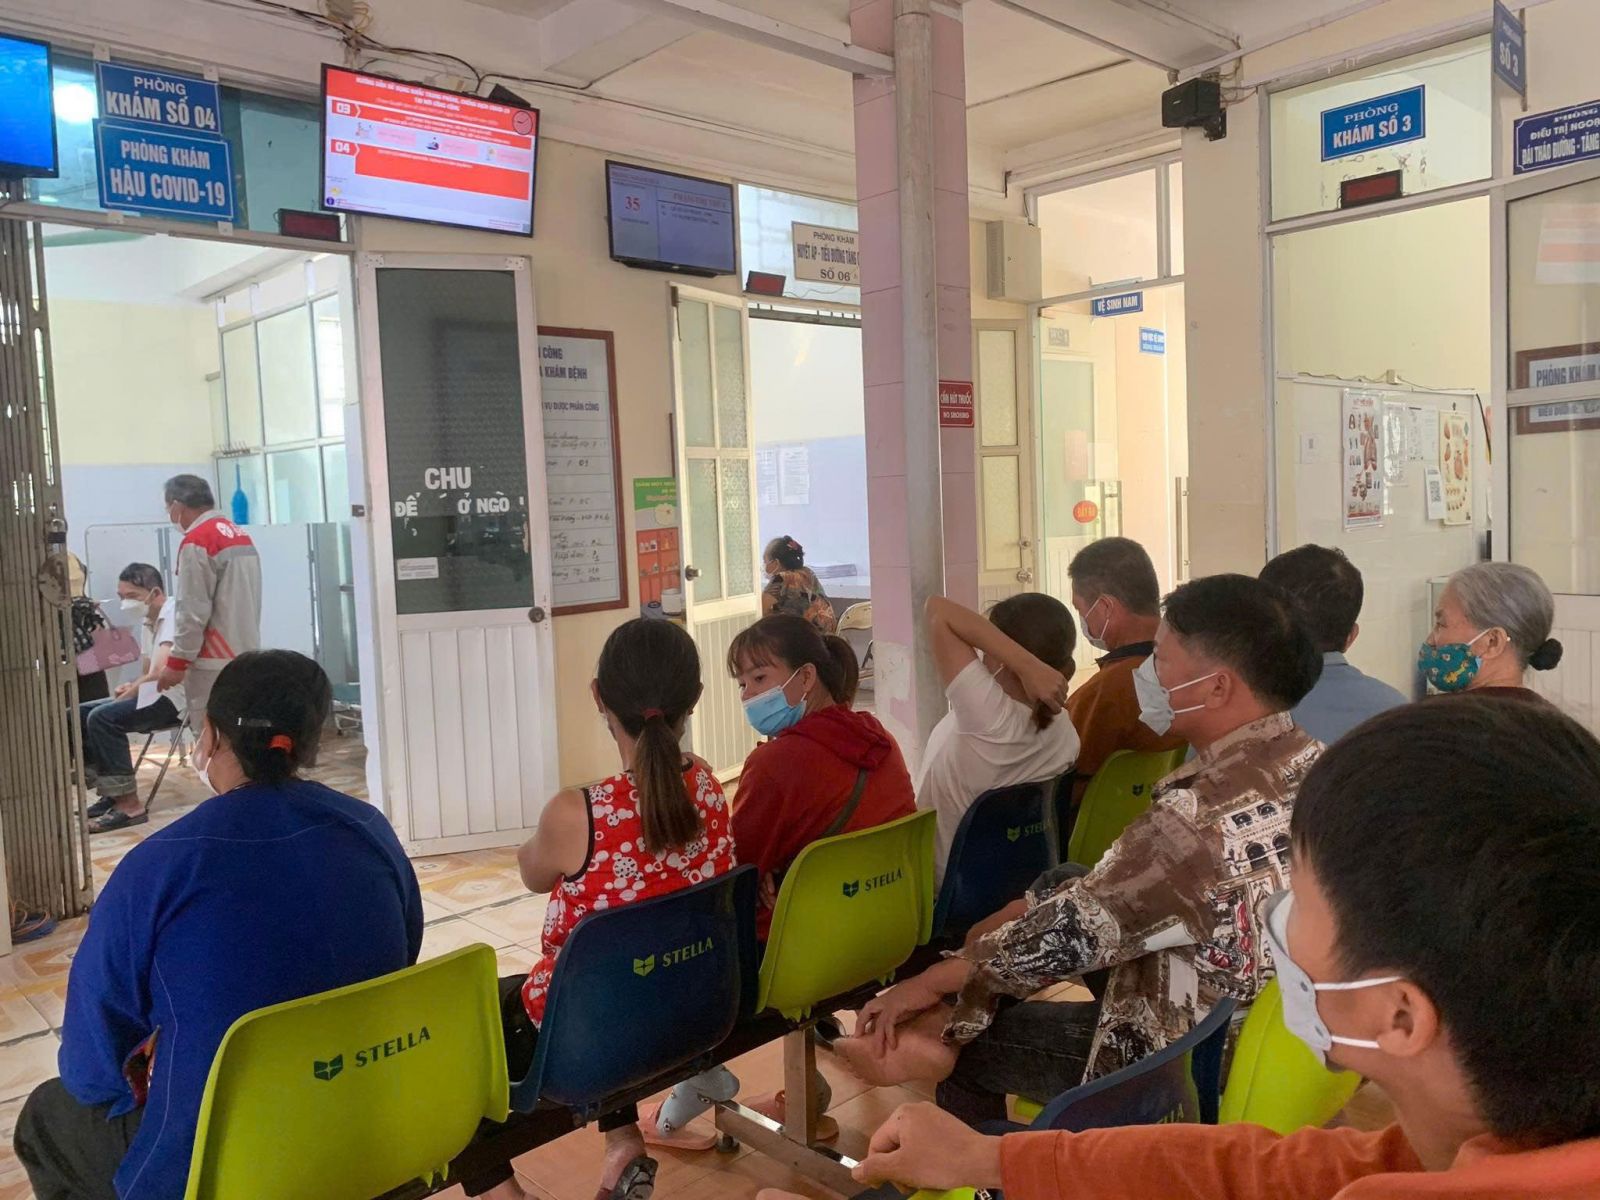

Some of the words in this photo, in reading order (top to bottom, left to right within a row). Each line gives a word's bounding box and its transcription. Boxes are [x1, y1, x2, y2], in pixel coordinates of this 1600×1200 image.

[1499, 41, 1511, 70] SỐ
[1512, 53, 1519, 77] 3
[133, 76, 187, 95] PHÒNG
[106, 91, 161, 121] KHÁM
[165, 96, 190, 125] SỐ
[194, 105, 216, 129] 04
[336, 101, 350, 115] 03
[1344, 103, 1399, 124] PHÒNG
[1333, 124, 1375, 149] KHÁM
[1378, 112, 1398, 137] SỐ
[1402, 114, 1412, 132] 3
[1530, 126, 1552, 140] ĐIỀU
[1553, 122, 1568, 135] TRỊ
[121, 138, 168, 164] PHÒNG
[171, 147, 210, 170] KHÁM
[335, 141, 350, 154] 04
[110, 164, 146, 201] HẬU
[150, 172, 226, 206] COVID-19
[624, 195, 641, 211] 35
[813, 231, 835, 242] PHÒNG
[820, 267, 835, 280] SỐ
[837, 271, 851, 282] 06
[1097, 298, 1105, 313] VỆ
[1106, 298, 1121, 311] SINH
[1122, 295, 1138, 308] NAM
[865, 867, 902, 891] STELLA
[662, 936, 714, 967] STELLA
[355, 1026, 431, 1067] STELLA
